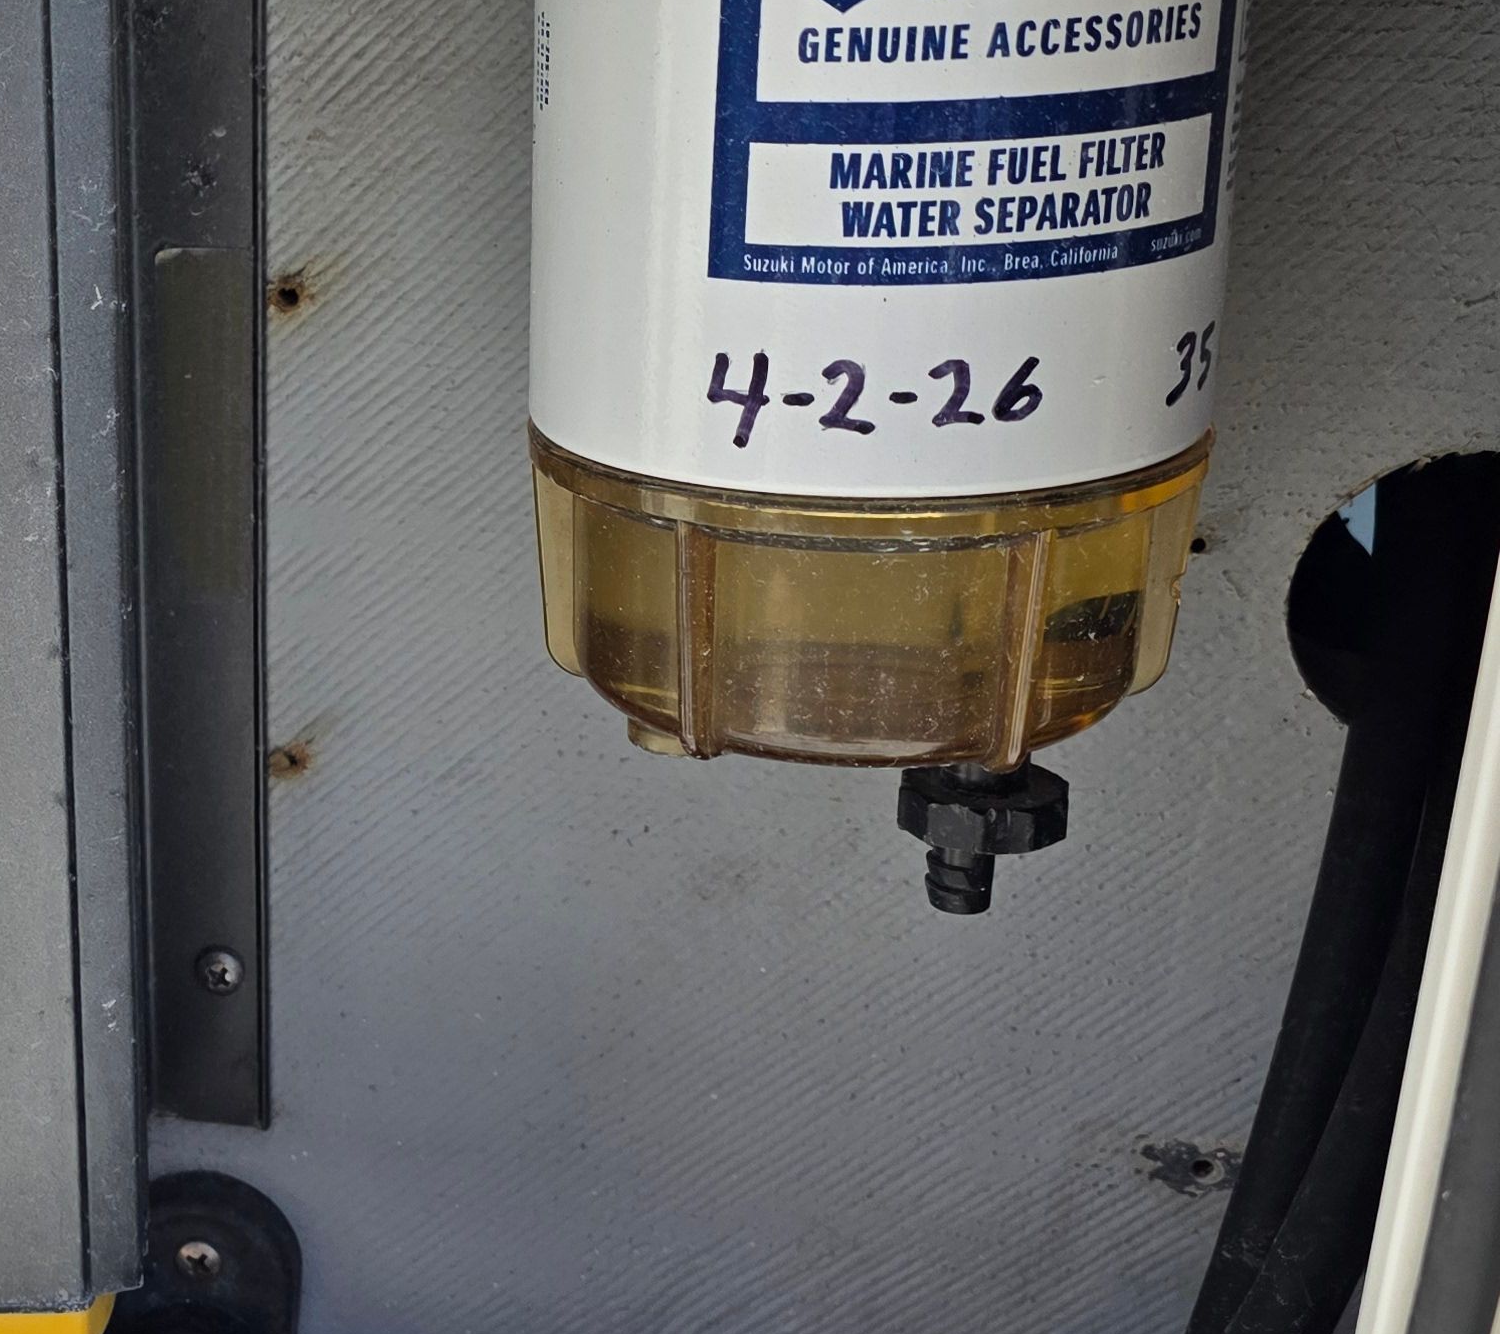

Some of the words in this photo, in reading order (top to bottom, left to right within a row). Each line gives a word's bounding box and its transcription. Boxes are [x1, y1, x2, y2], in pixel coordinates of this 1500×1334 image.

[798, 23, 969, 64] GENUINE
[987, 2, 1202, 57] ACCESSORIES
[829, 148, 973, 189] MARINE
[987, 143, 1066, 186] FUEL
[1078, 132, 1165, 180] FILTER
[841, 198, 960, 239] WATER
[974, 183, 1152, 235] SEPARATOR
[744, 254, 795, 273] Suzuki
[801, 256, 850, 275] Motor
[857, 257, 875, 275] of
[1051, 246, 1118, 267] California
[706, 349, 1043, 448] 4-2-26
